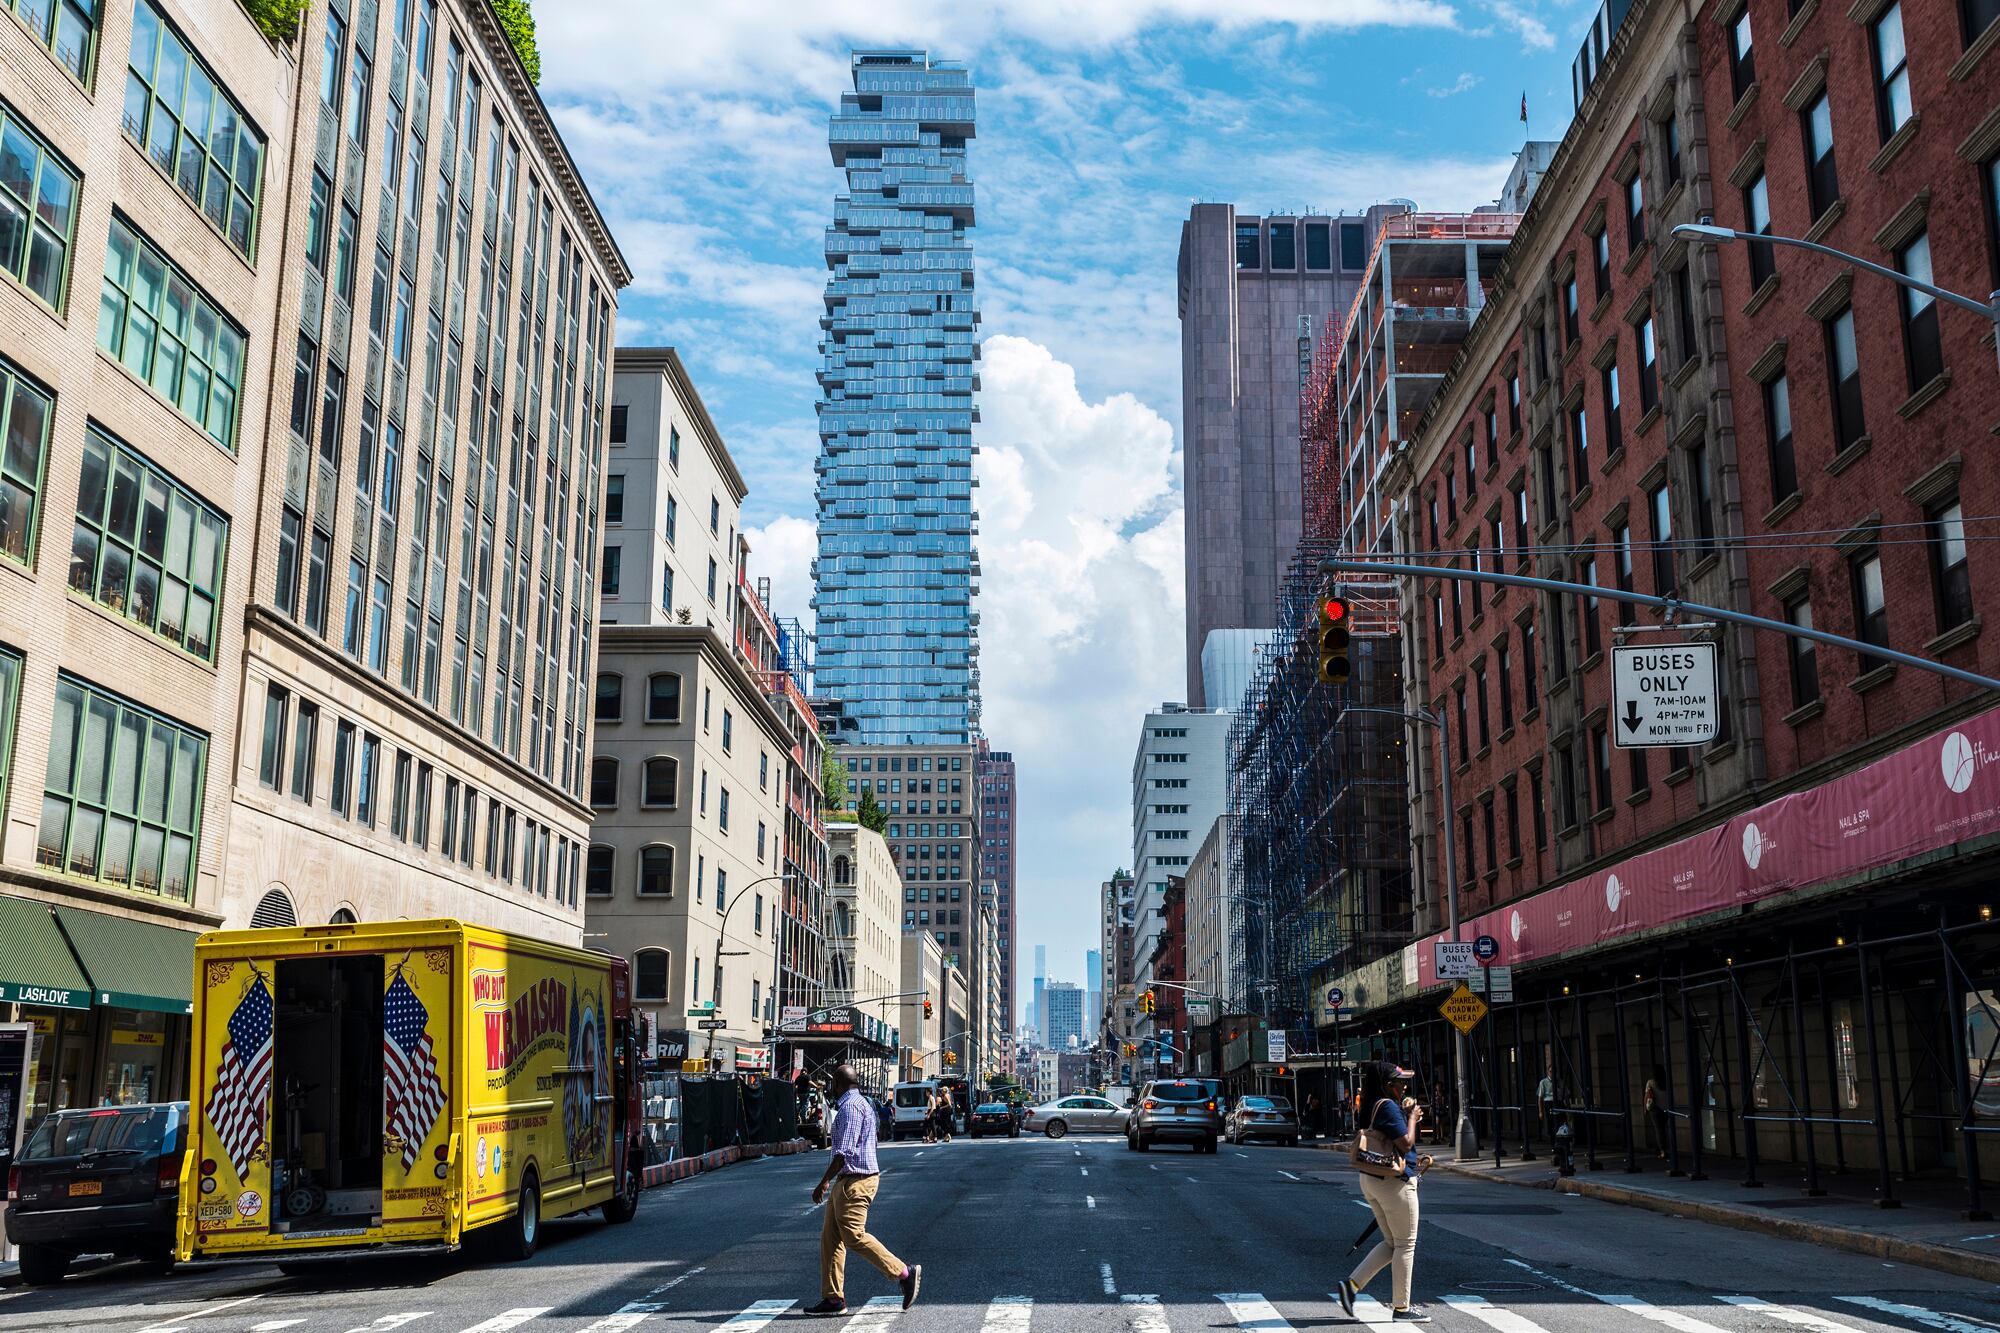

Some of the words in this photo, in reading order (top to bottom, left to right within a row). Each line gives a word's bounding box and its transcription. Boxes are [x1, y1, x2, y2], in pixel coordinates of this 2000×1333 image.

[1633, 654, 1695, 671] BUSES
[1640, 676, 1689, 692] ONLY
[1654, 695, 1706, 706] 7AM-10AM
[1657, 710, 1705, 720] 4PM-7PM
[1650, 725, 1671, 736] MON
[1675, 726, 1693, 734] THRU
[1697, 724, 1713, 735] FRI
[1839, 817, 1852, 829] NAIL
[1853, 813, 1858, 821] &
[1858, 808, 1870, 820] SPA
[1673, 874, 1682, 884] NAIL
[1686, 870, 1695, 879] SPA
[1442, 945, 1471, 953] BUSES
[1446, 955, 1468, 963] ONLY
[473, 974, 489, 1001] WHO
[492, 974, 506, 1000] BUT
[19, 987, 70, 1004] LASHLOVE
[1450, 997, 1476, 1005] SHARED
[1447, 1005, 1480, 1013] ROADWAY
[1453, 1014, 1477, 1022] AHEAD
[487, 1069, 516, 1091] PRODUCTS
[516, 1059, 527, 1075] FOR
[526, 1047, 537, 1064] THE
[537, 1037, 566, 1053] WORKPLACE
